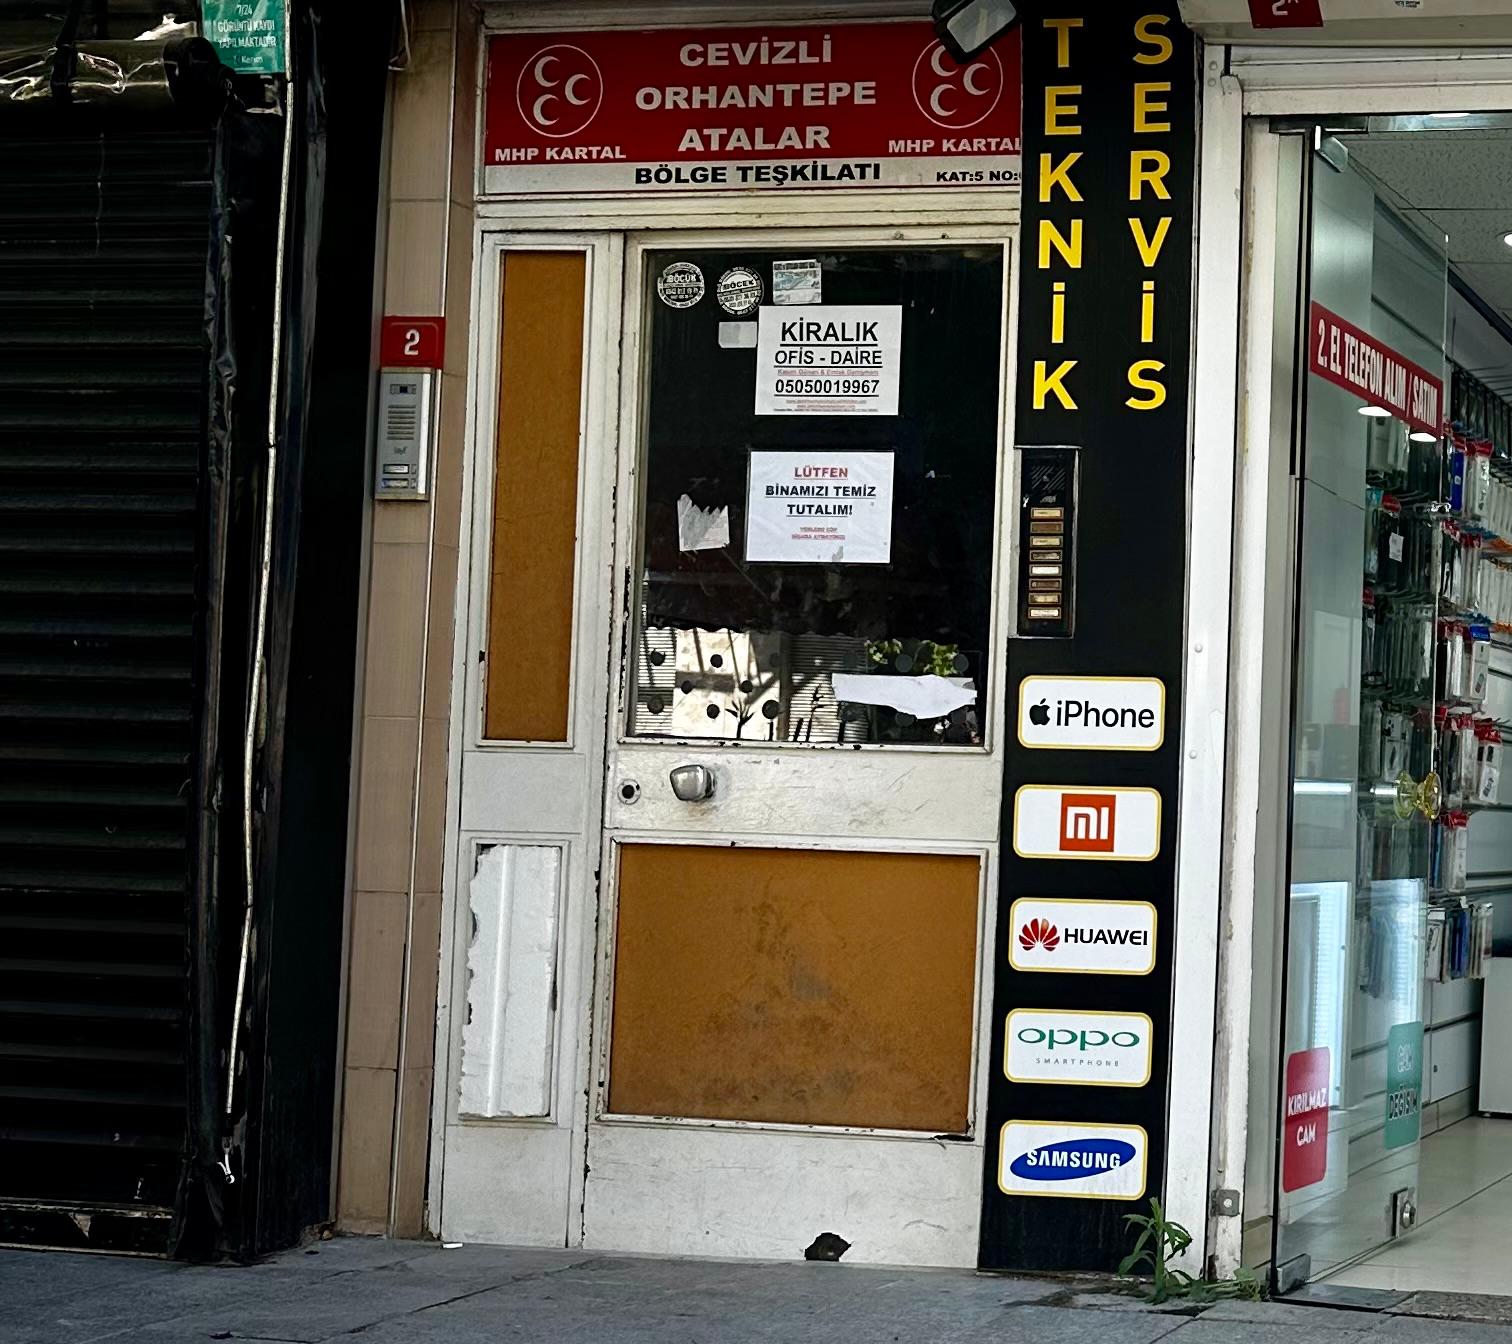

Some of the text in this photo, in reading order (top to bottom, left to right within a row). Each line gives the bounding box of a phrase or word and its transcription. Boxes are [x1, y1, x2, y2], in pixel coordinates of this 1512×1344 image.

[679, 34, 832, 67] CEVİZLİ
[635, 81, 877, 111] ORHANTEPE
[678, 125, 831, 152] ATALAR
[888, 137, 1021, 154] MHP KARTAL
[495, 145, 627, 161] MHP KARTAL
[634, 161, 881, 187] BÖLGE TEŞKİLATI
[936, 170, 1021, 182] KAT:5 NO:
[1032, 17, 1084, 411] TEKNİK
[1125, 14, 1174, 411] SERVİS
[781, 316, 879, 342] KİRALIK
[404, 328, 420, 355] 2
[774, 347, 814, 365] OFİS
[830, 347, 883, 365] DAİRE
[775, 379, 880, 394] 05050019967
[1329, 324, 1342, 376] EL
[1344, 332, 1384, 398] TELEFON
[1383, 357, 1407, 412] ALIM
[1412, 375, 1438, 429] SATIM
[794, 464, 849, 478] LÜTFEN
[765, 483, 877, 497] BİNAMIZI TEMİZ
[787, 504, 853, 515] TUTALIM!
[1056, 700, 1155, 728] iPhone
[1064, 927, 1148, 946] HUAWEI
[1036, 1057, 1120, 1067] SMARTPHONE
[1287, 1087, 1327, 1118] KIRILMAZ
[1296, 1123, 1316, 1147] CAM
[1026, 1149, 1122, 1169] SAMSUNG
